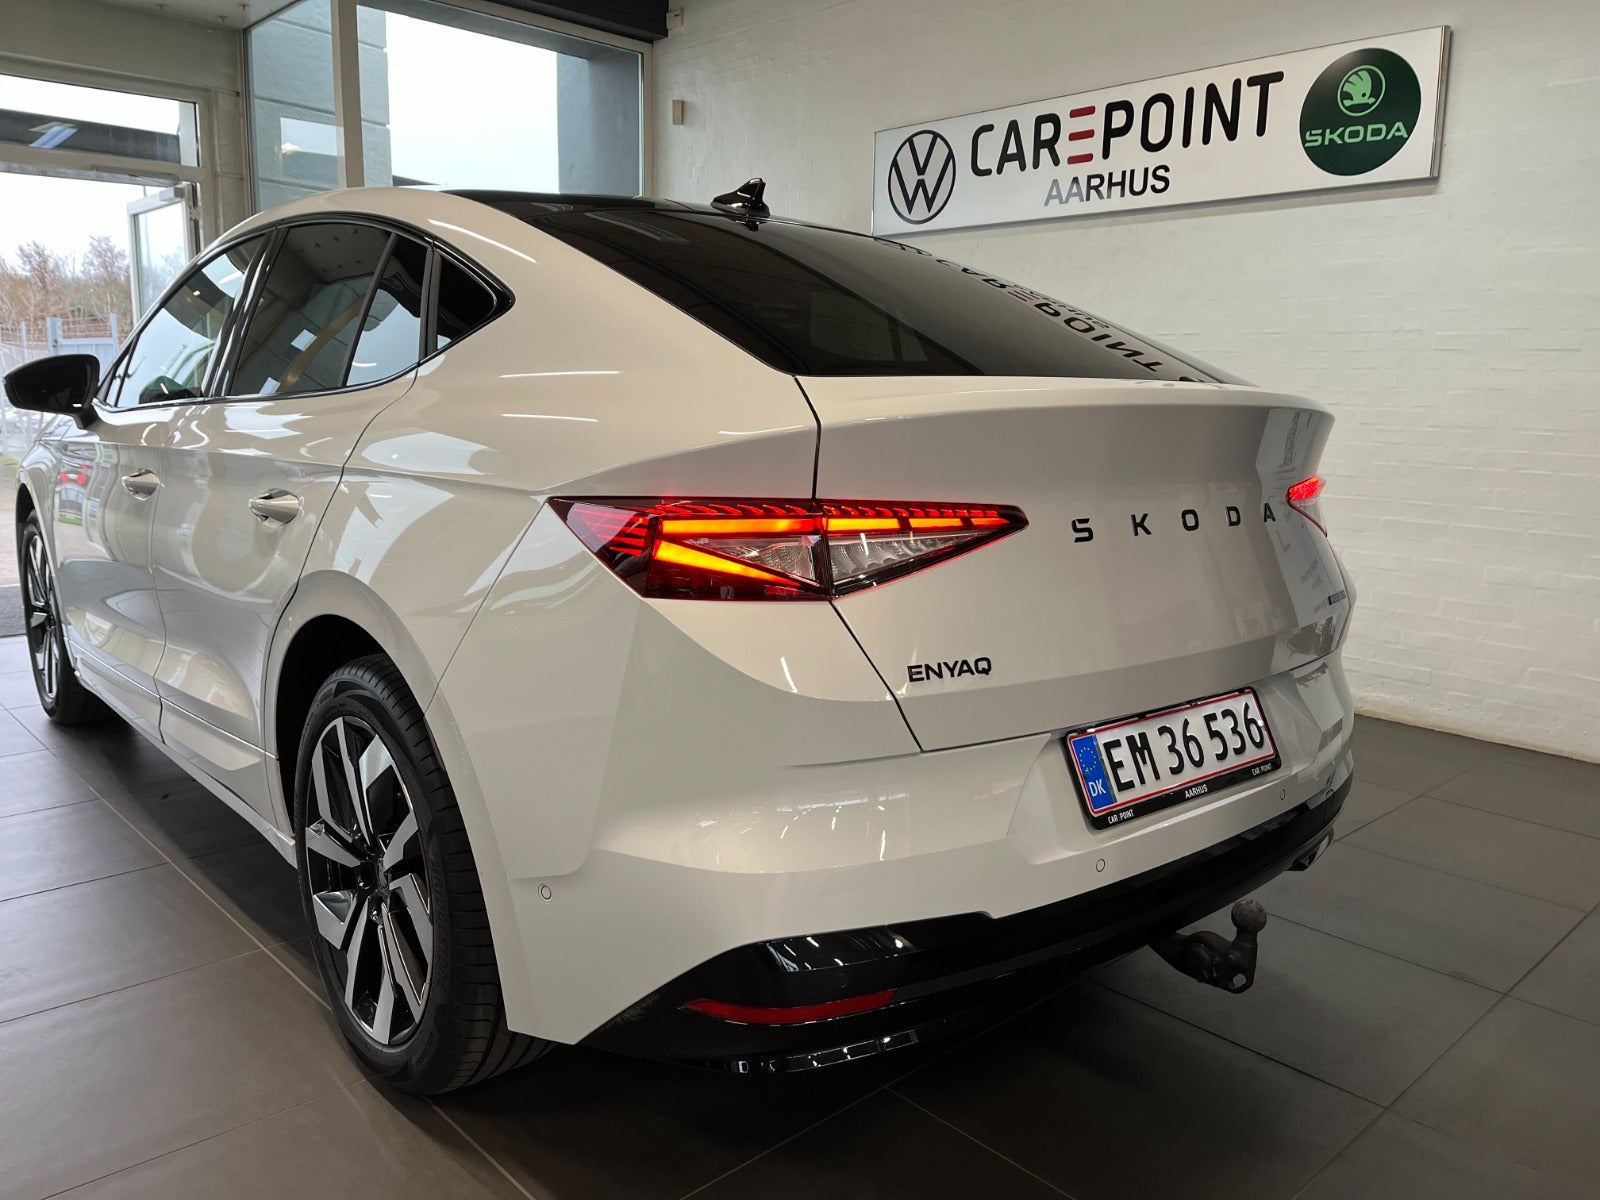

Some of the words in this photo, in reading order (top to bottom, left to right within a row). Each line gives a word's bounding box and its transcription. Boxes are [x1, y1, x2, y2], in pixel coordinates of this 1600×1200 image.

[1044, 163, 1171, 208] AARHUS
[907, 656, 992, 683] ENYAQ
[1103, 731, 1160, 792] EM
[1157, 718, 1204, 775] 36
[1203, 702, 1265, 761] 536
[1088, 778, 1107, 798] DK
[1185, 784, 1208, 799] AARHUS
